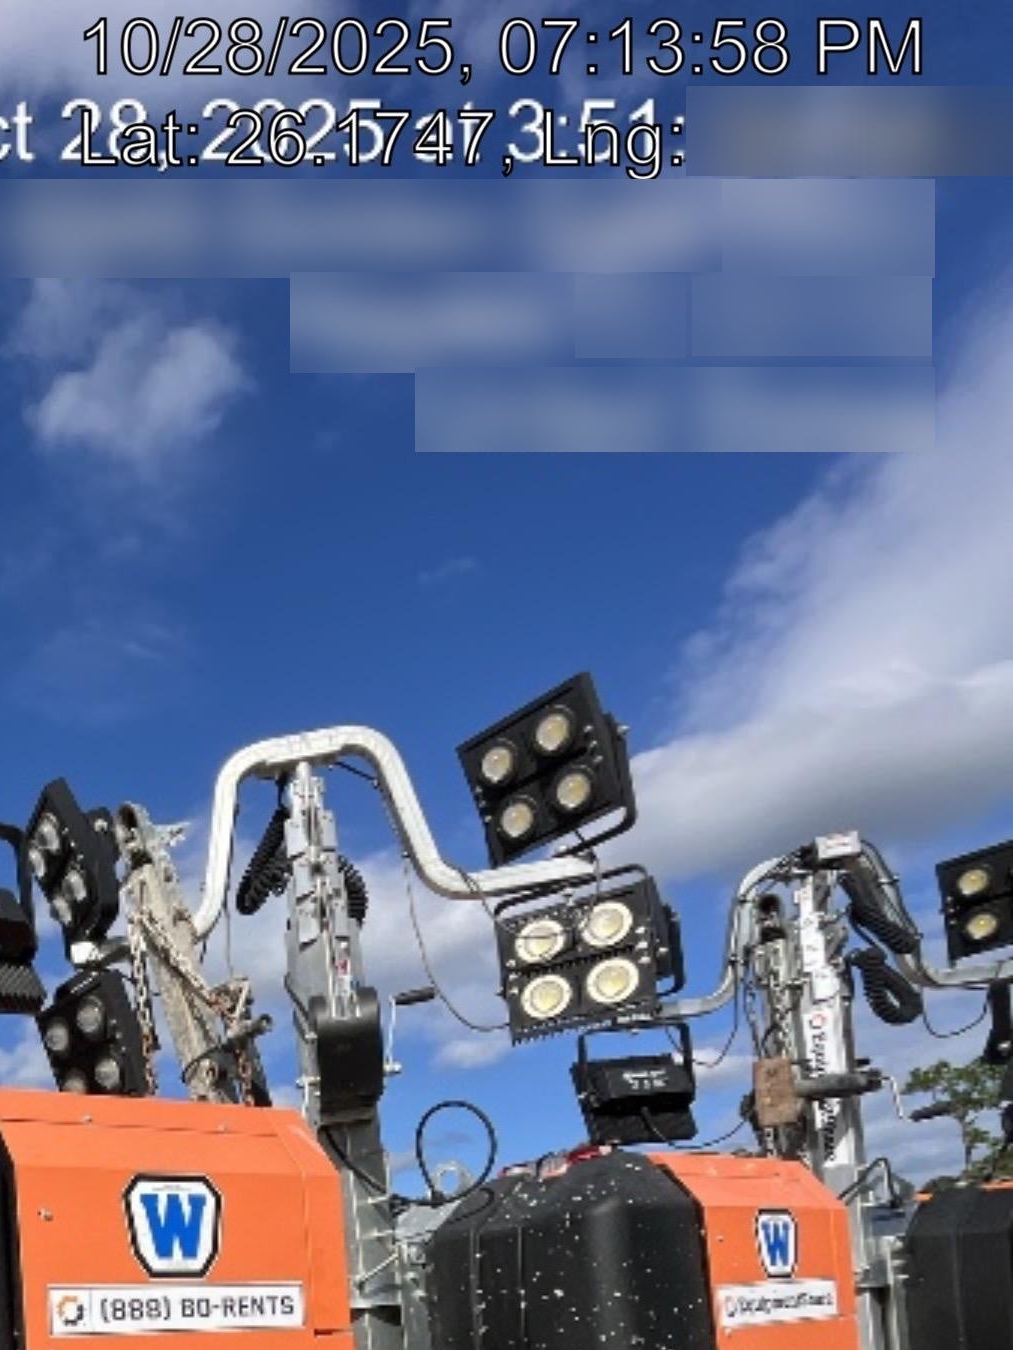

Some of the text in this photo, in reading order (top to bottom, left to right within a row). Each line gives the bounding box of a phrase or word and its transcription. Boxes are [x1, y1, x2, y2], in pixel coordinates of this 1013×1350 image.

[140, 1194, 206, 1259] W
[761, 1220, 790, 1266] W
[100, 1297, 171, 1322] (888)
